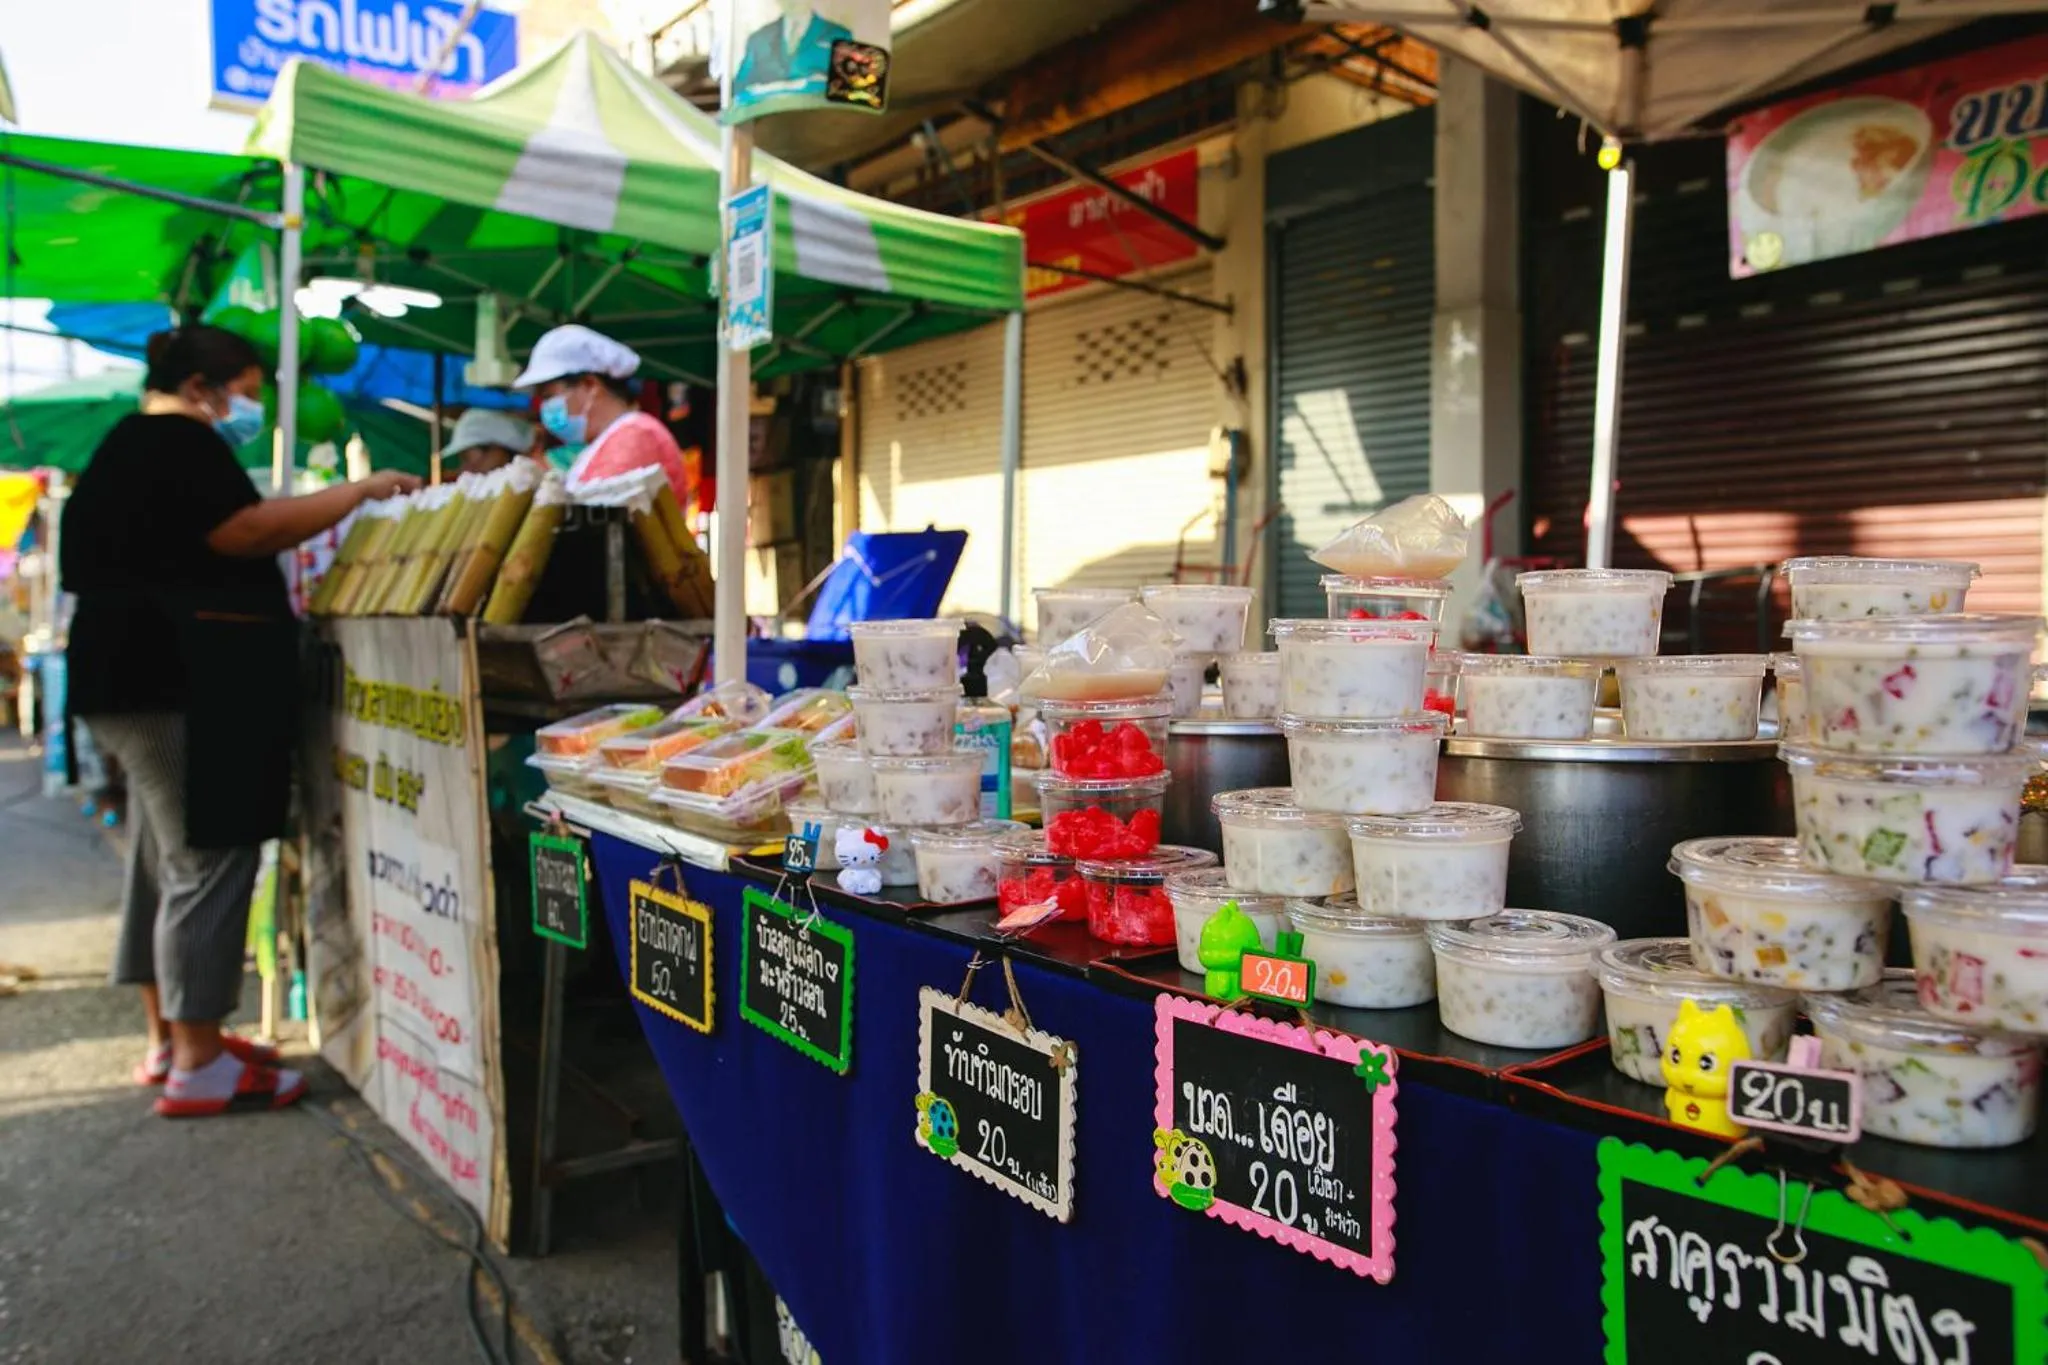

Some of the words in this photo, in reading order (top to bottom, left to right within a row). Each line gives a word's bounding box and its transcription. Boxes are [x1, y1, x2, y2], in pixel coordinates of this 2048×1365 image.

[253, 0, 486, 84] รถไฟฟ้า
[944, 1031, 1042, 1120] ทับทิมกรอบ
[1627, 1214, 1977, 1365] สาคูรวมมิตร
